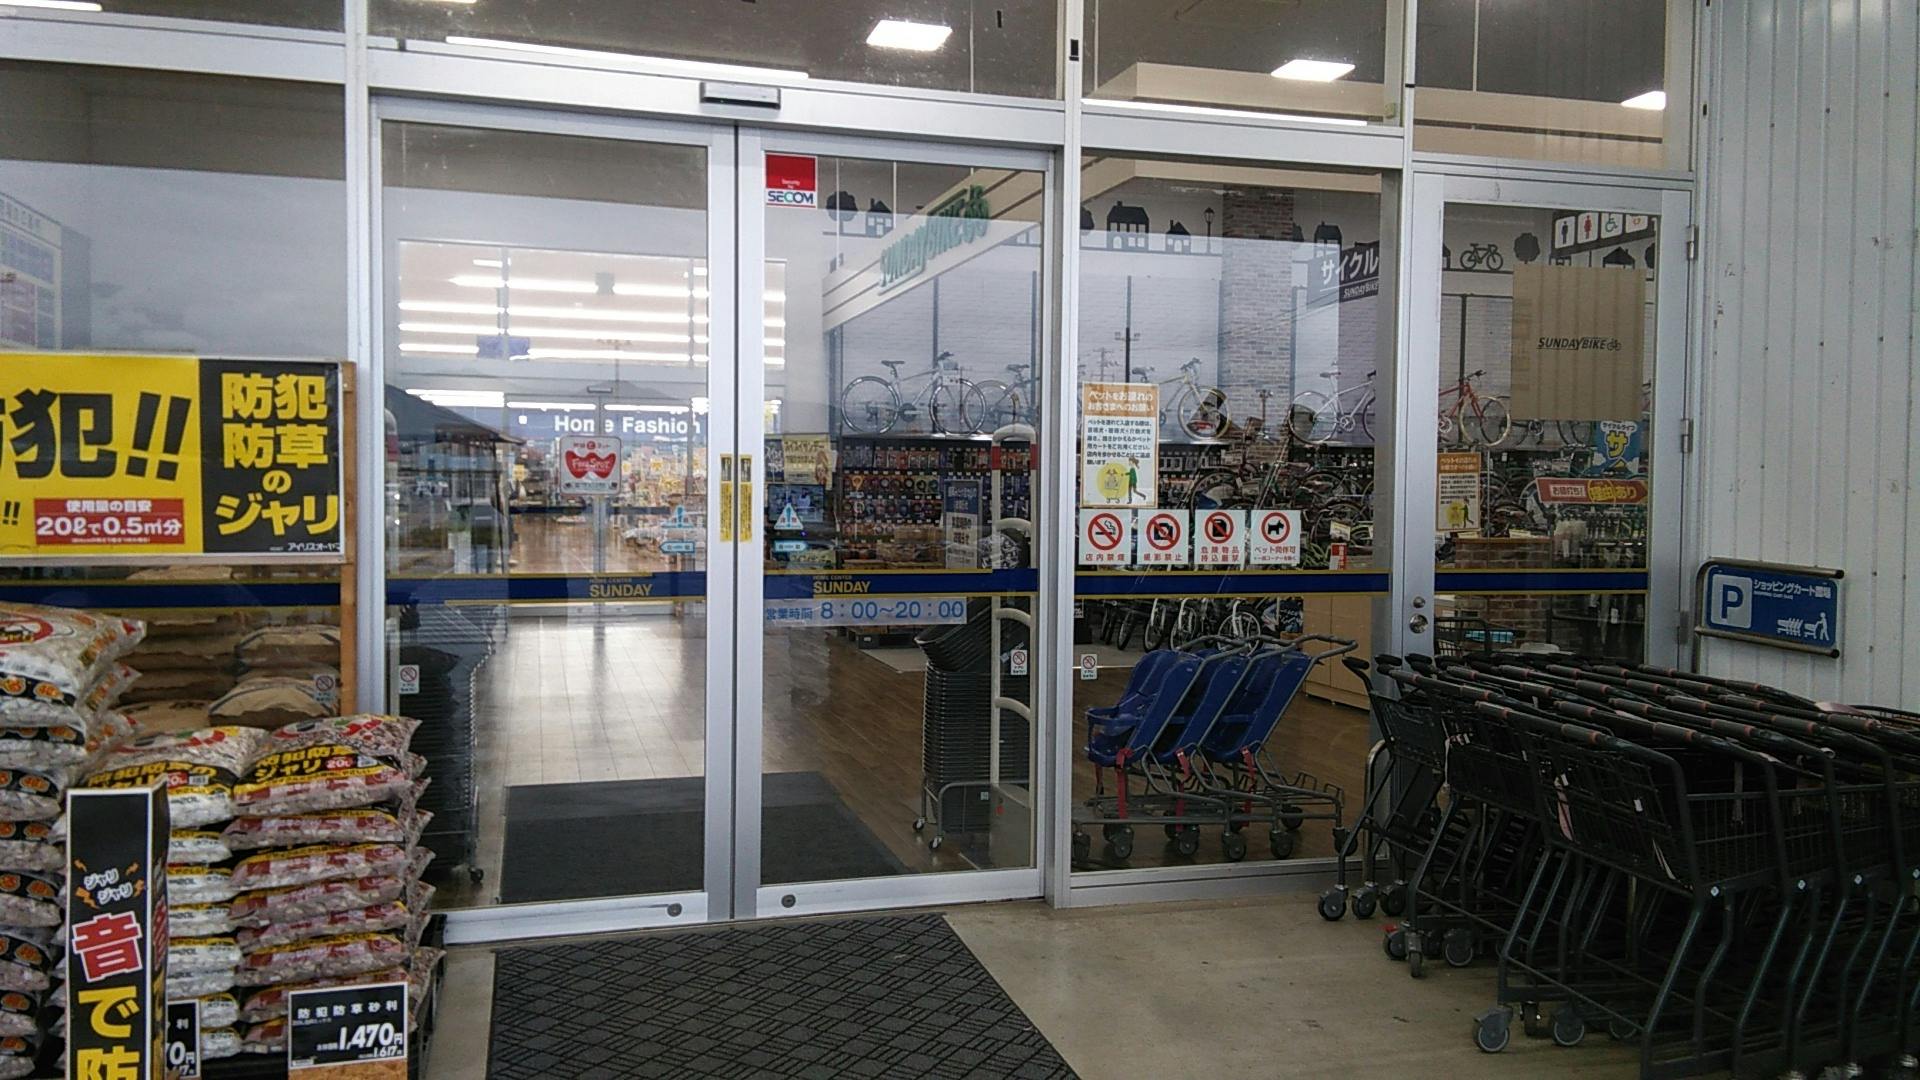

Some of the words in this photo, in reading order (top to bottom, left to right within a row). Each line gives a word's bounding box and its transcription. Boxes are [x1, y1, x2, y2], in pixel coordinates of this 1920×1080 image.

[767, 190, 813, 204] SECOM
[1321, 247, 1379, 285] サイクル
[1537, 337, 1606, 351] SUNDAYBIKE
[222, 373, 329, 420] 防犯
[0, 388, 192, 482] 犯!!
[554, 415, 615, 433] Home
[622, 416, 701, 434] Fashion
[223, 423, 329, 469] 防草
[263, 470, 292, 494] の
[215, 493, 339, 536] ジャリ
[589, 584, 653, 598] SUNDAY
[813, 581, 871, 593] SUNDAY
[1721, 584, 1744, 619] P
[766, 608, 813, 620] 営業時間
[84, 868, 119, 890] ジャリ
[98, 882, 133, 904] ジャリ
